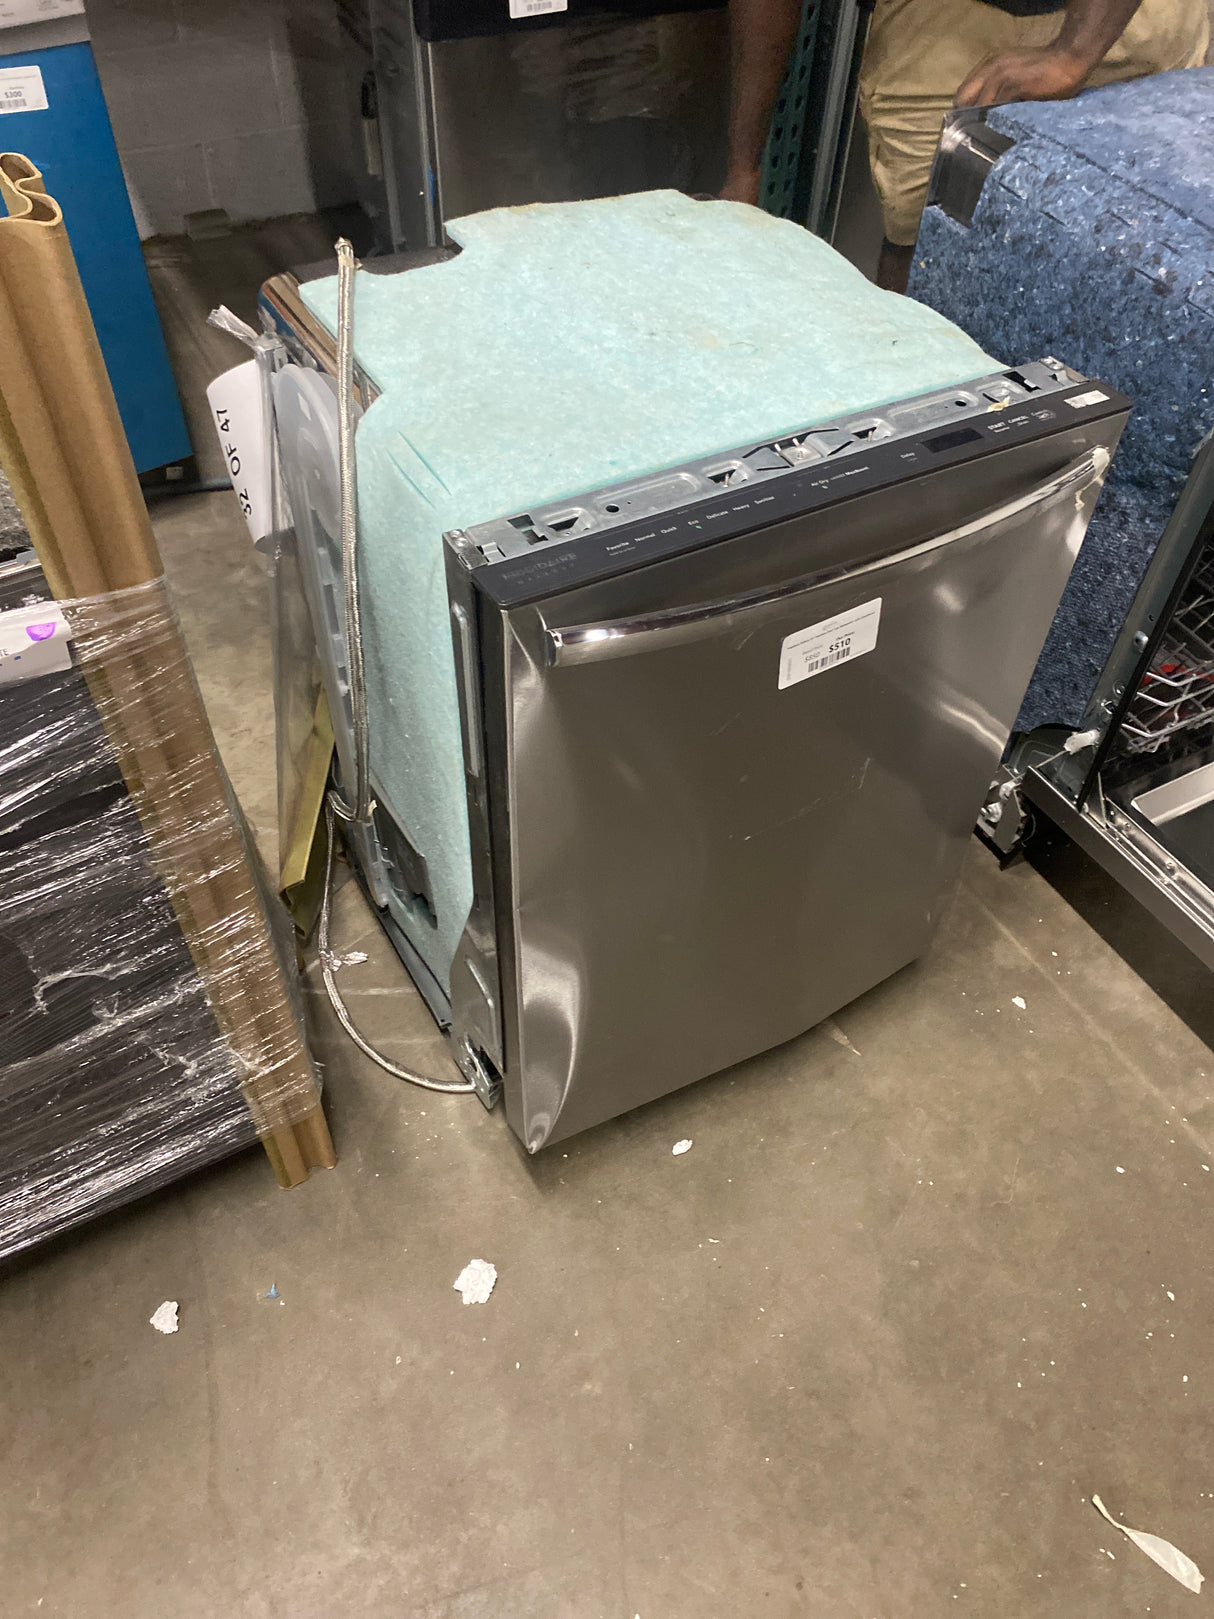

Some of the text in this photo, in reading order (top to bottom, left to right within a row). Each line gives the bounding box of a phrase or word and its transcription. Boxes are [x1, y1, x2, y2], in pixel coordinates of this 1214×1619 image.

[216, 409, 252, 519] 32 OF 47
[828, 637, 851, 653] $510
